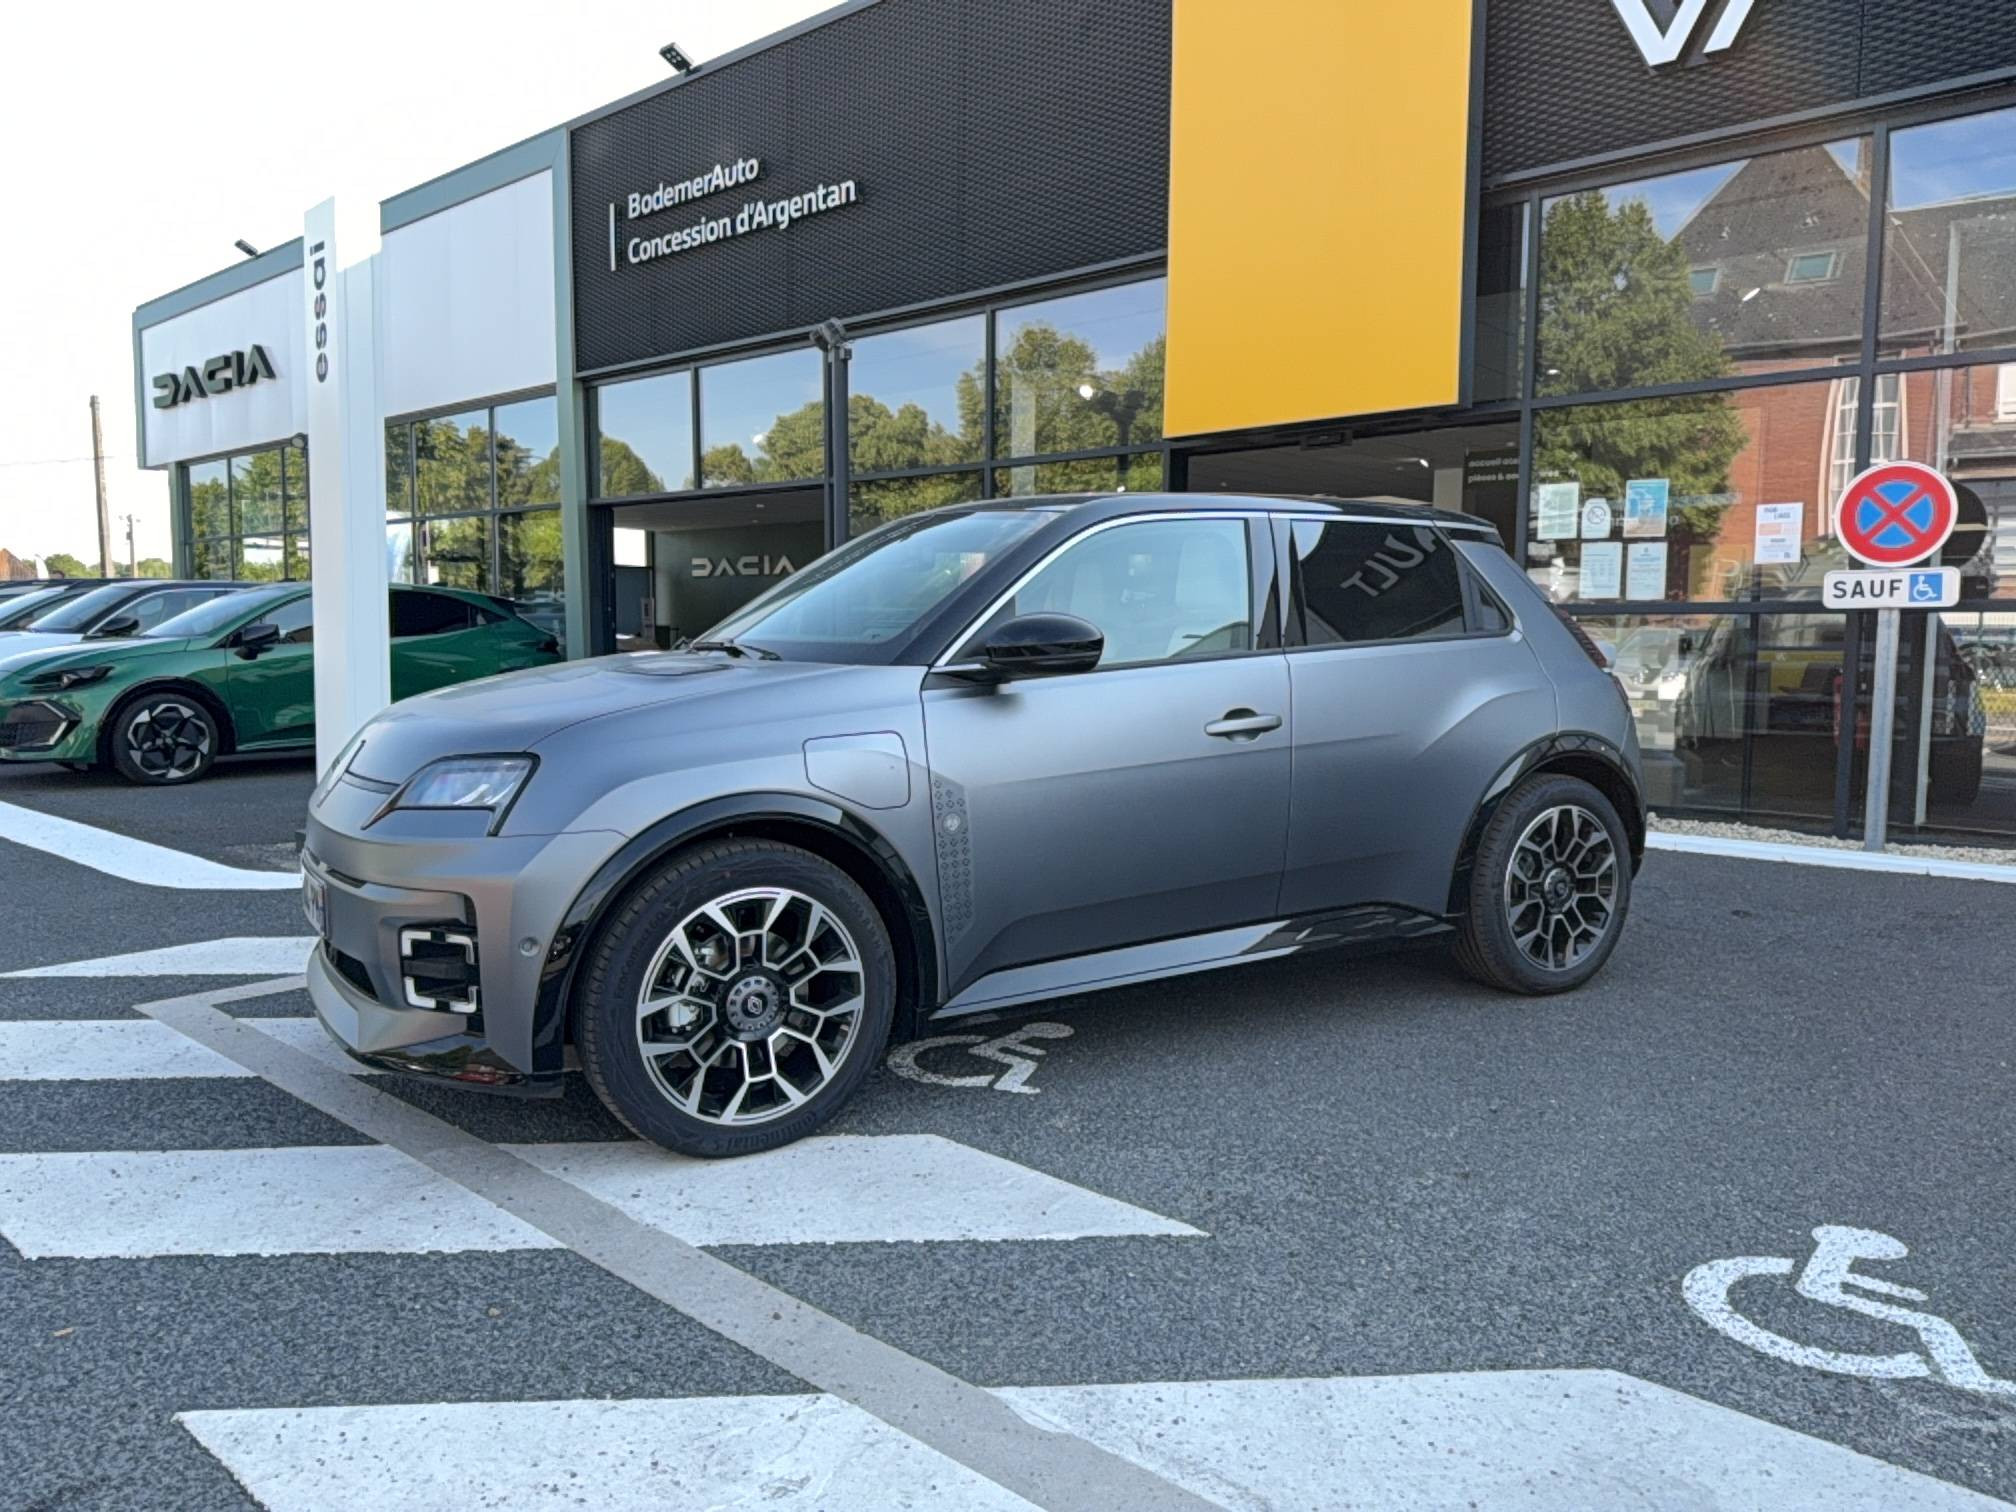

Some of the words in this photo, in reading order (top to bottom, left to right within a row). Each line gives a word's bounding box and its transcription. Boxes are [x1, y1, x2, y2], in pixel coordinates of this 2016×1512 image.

[628, 157, 759, 219] BodemerAuto
[628, 216, 732, 264] Concession
[735, 179, 856, 234] d'Argentan
[310, 240, 328, 383] essai
[153, 344, 276, 409] DACIA
[691, 555, 796, 577] DACIA
[1833, 579, 1903, 599] SAUF
